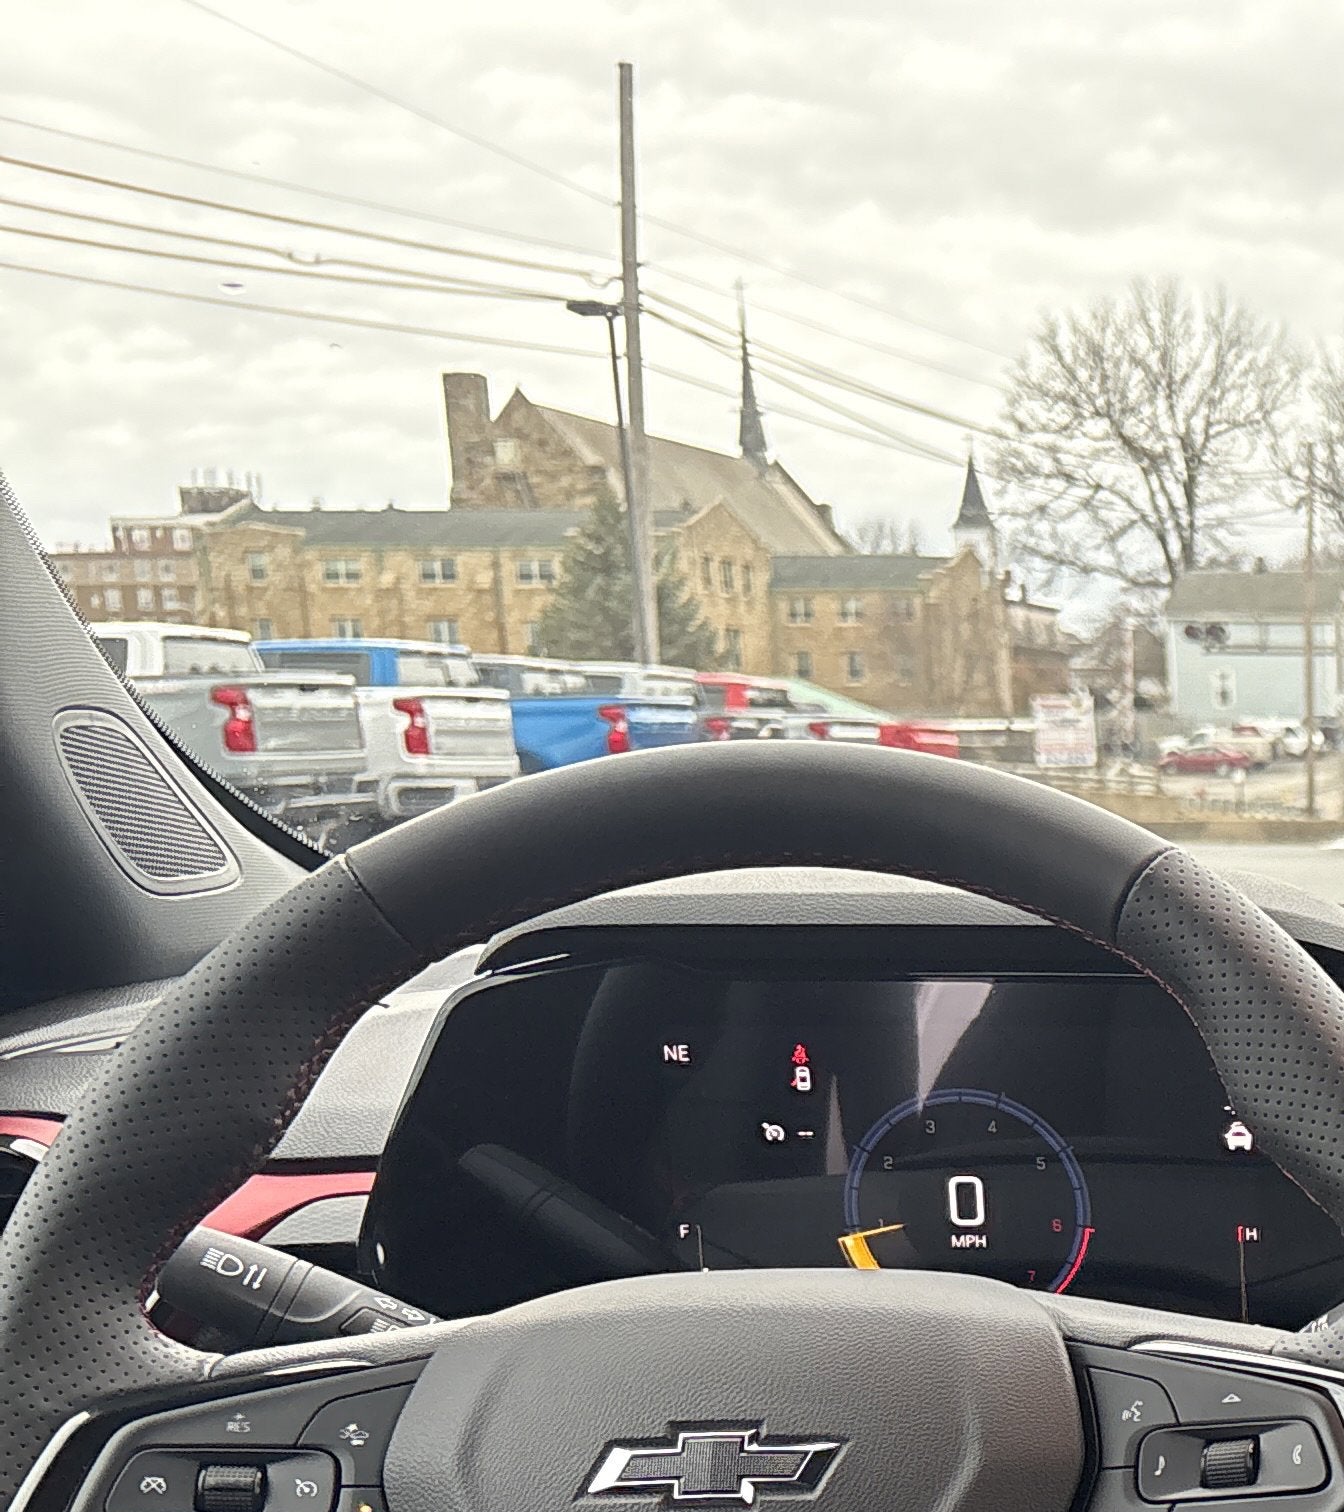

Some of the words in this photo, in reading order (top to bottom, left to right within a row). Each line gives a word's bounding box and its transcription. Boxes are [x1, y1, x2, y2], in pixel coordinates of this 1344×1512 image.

[663, 1044, 690, 1062] NE
[925, 1120, 936, 1134] 3
[988, 1120, 998, 1133] 4
[884, 1156, 894, 1170] 2
[1036, 1157, 1046, 1170] 5
[948, 1175, 985, 1227] 0
[679, 1224, 690, 1239] F
[1052, 1219, 1063, 1233] 6
[951, 1234, 987, 1248] MPH
[1245, 1227, 1258, 1241] H
[1028, 1270, 1037, 1282] 7
